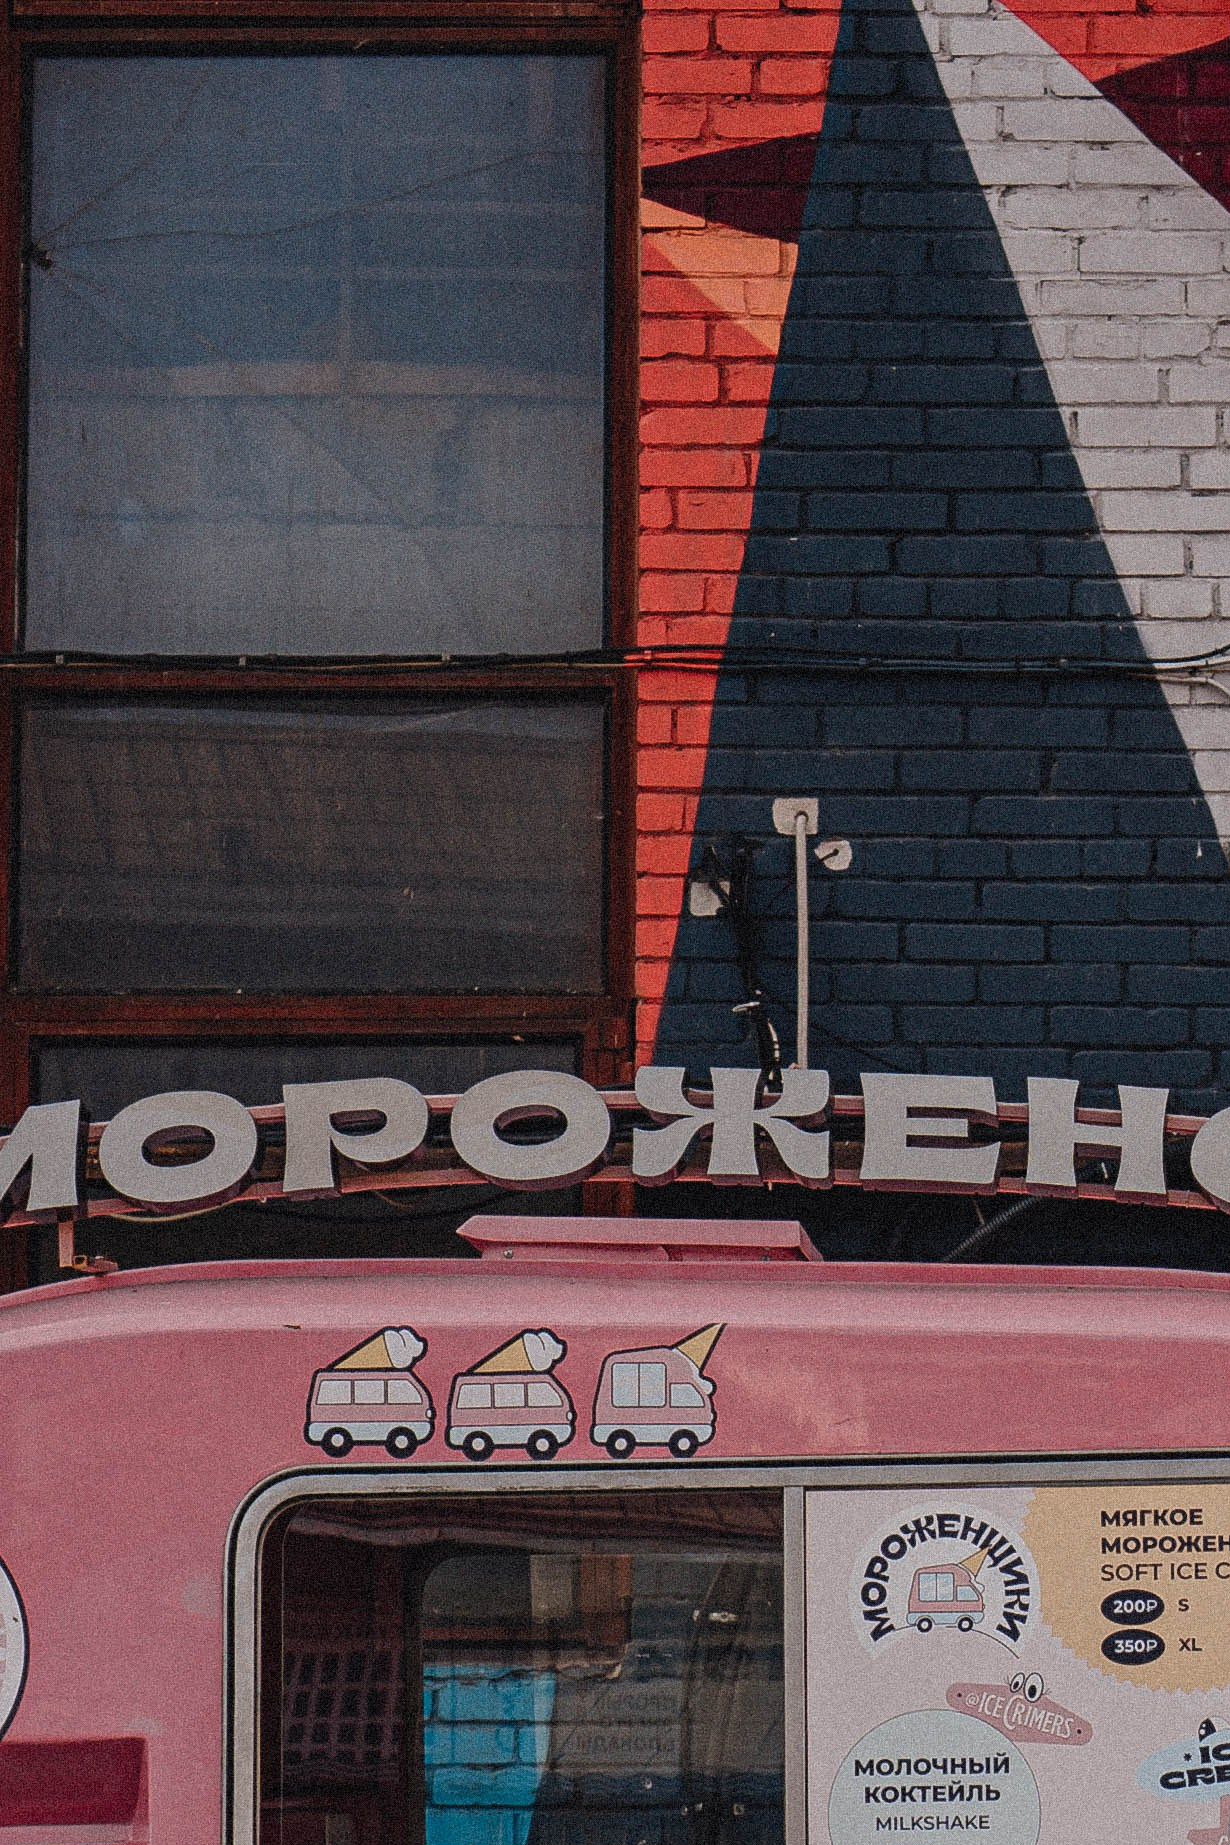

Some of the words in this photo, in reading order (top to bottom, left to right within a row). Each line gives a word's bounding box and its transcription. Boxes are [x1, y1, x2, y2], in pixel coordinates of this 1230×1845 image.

[1100, 1508, 1204, 1527] МЯГКОЕ
[861, 1513, 1031, 1643] МОРОЖЕНЩИКИ
[1100, 1563, 1163, 1582] SOFT
[1170, 1562, 1208, 1580] ICE
[1177, 1598, 1190, 1613] S
[1178, 1638, 1203, 1652] XL
[965, 1691, 1075, 1739] @ICECRIMERS
[854, 1752, 1011, 1777] МОЛОЧНЫЙ
[864, 1780, 1002, 1804] КОКТЕЙЛЬ
[875, 1814, 991, 1832] MILKSHAKE
